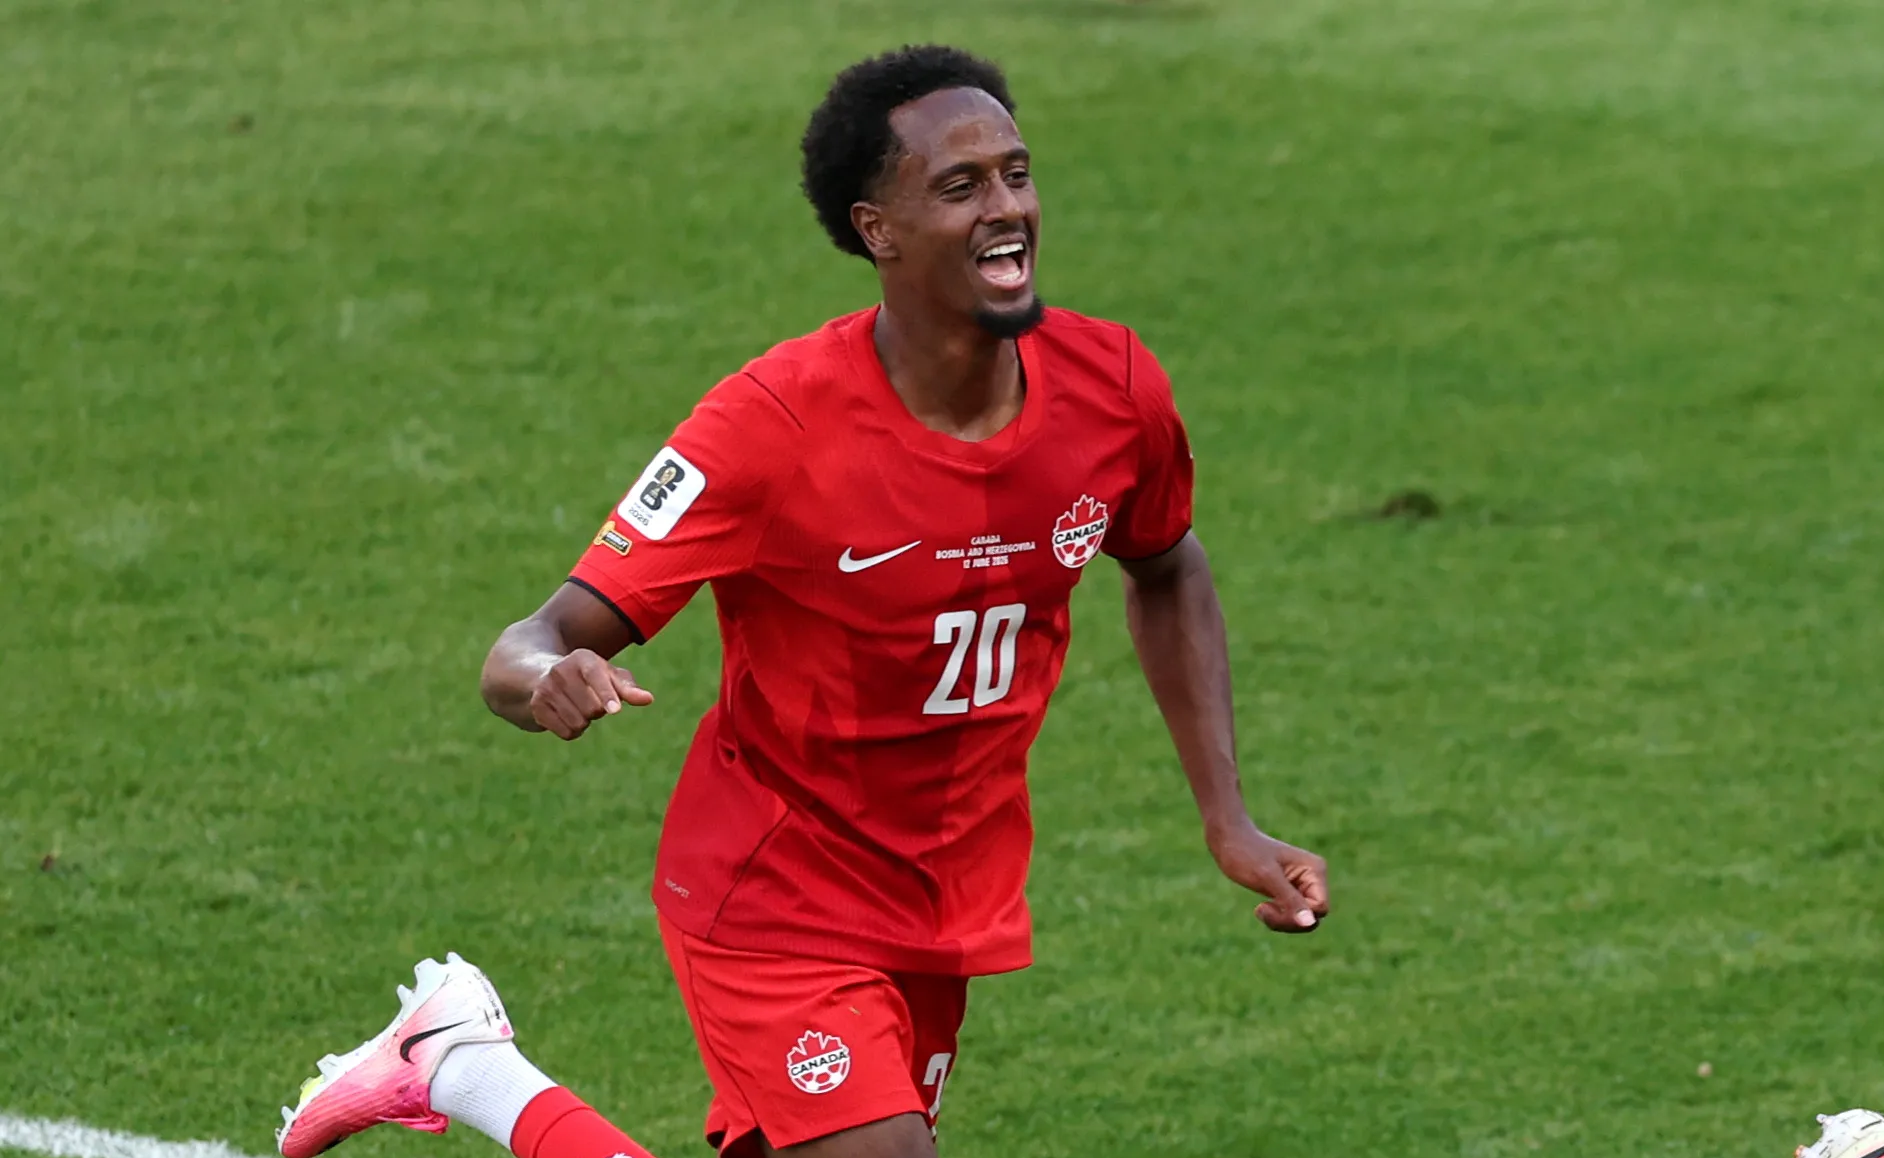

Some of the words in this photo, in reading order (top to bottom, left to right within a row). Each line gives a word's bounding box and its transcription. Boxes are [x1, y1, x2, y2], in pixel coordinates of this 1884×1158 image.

[1054, 521, 1105, 545] CANADA
[922, 603, 1027, 715] 20
[791, 1050, 848, 1077] CANADA
